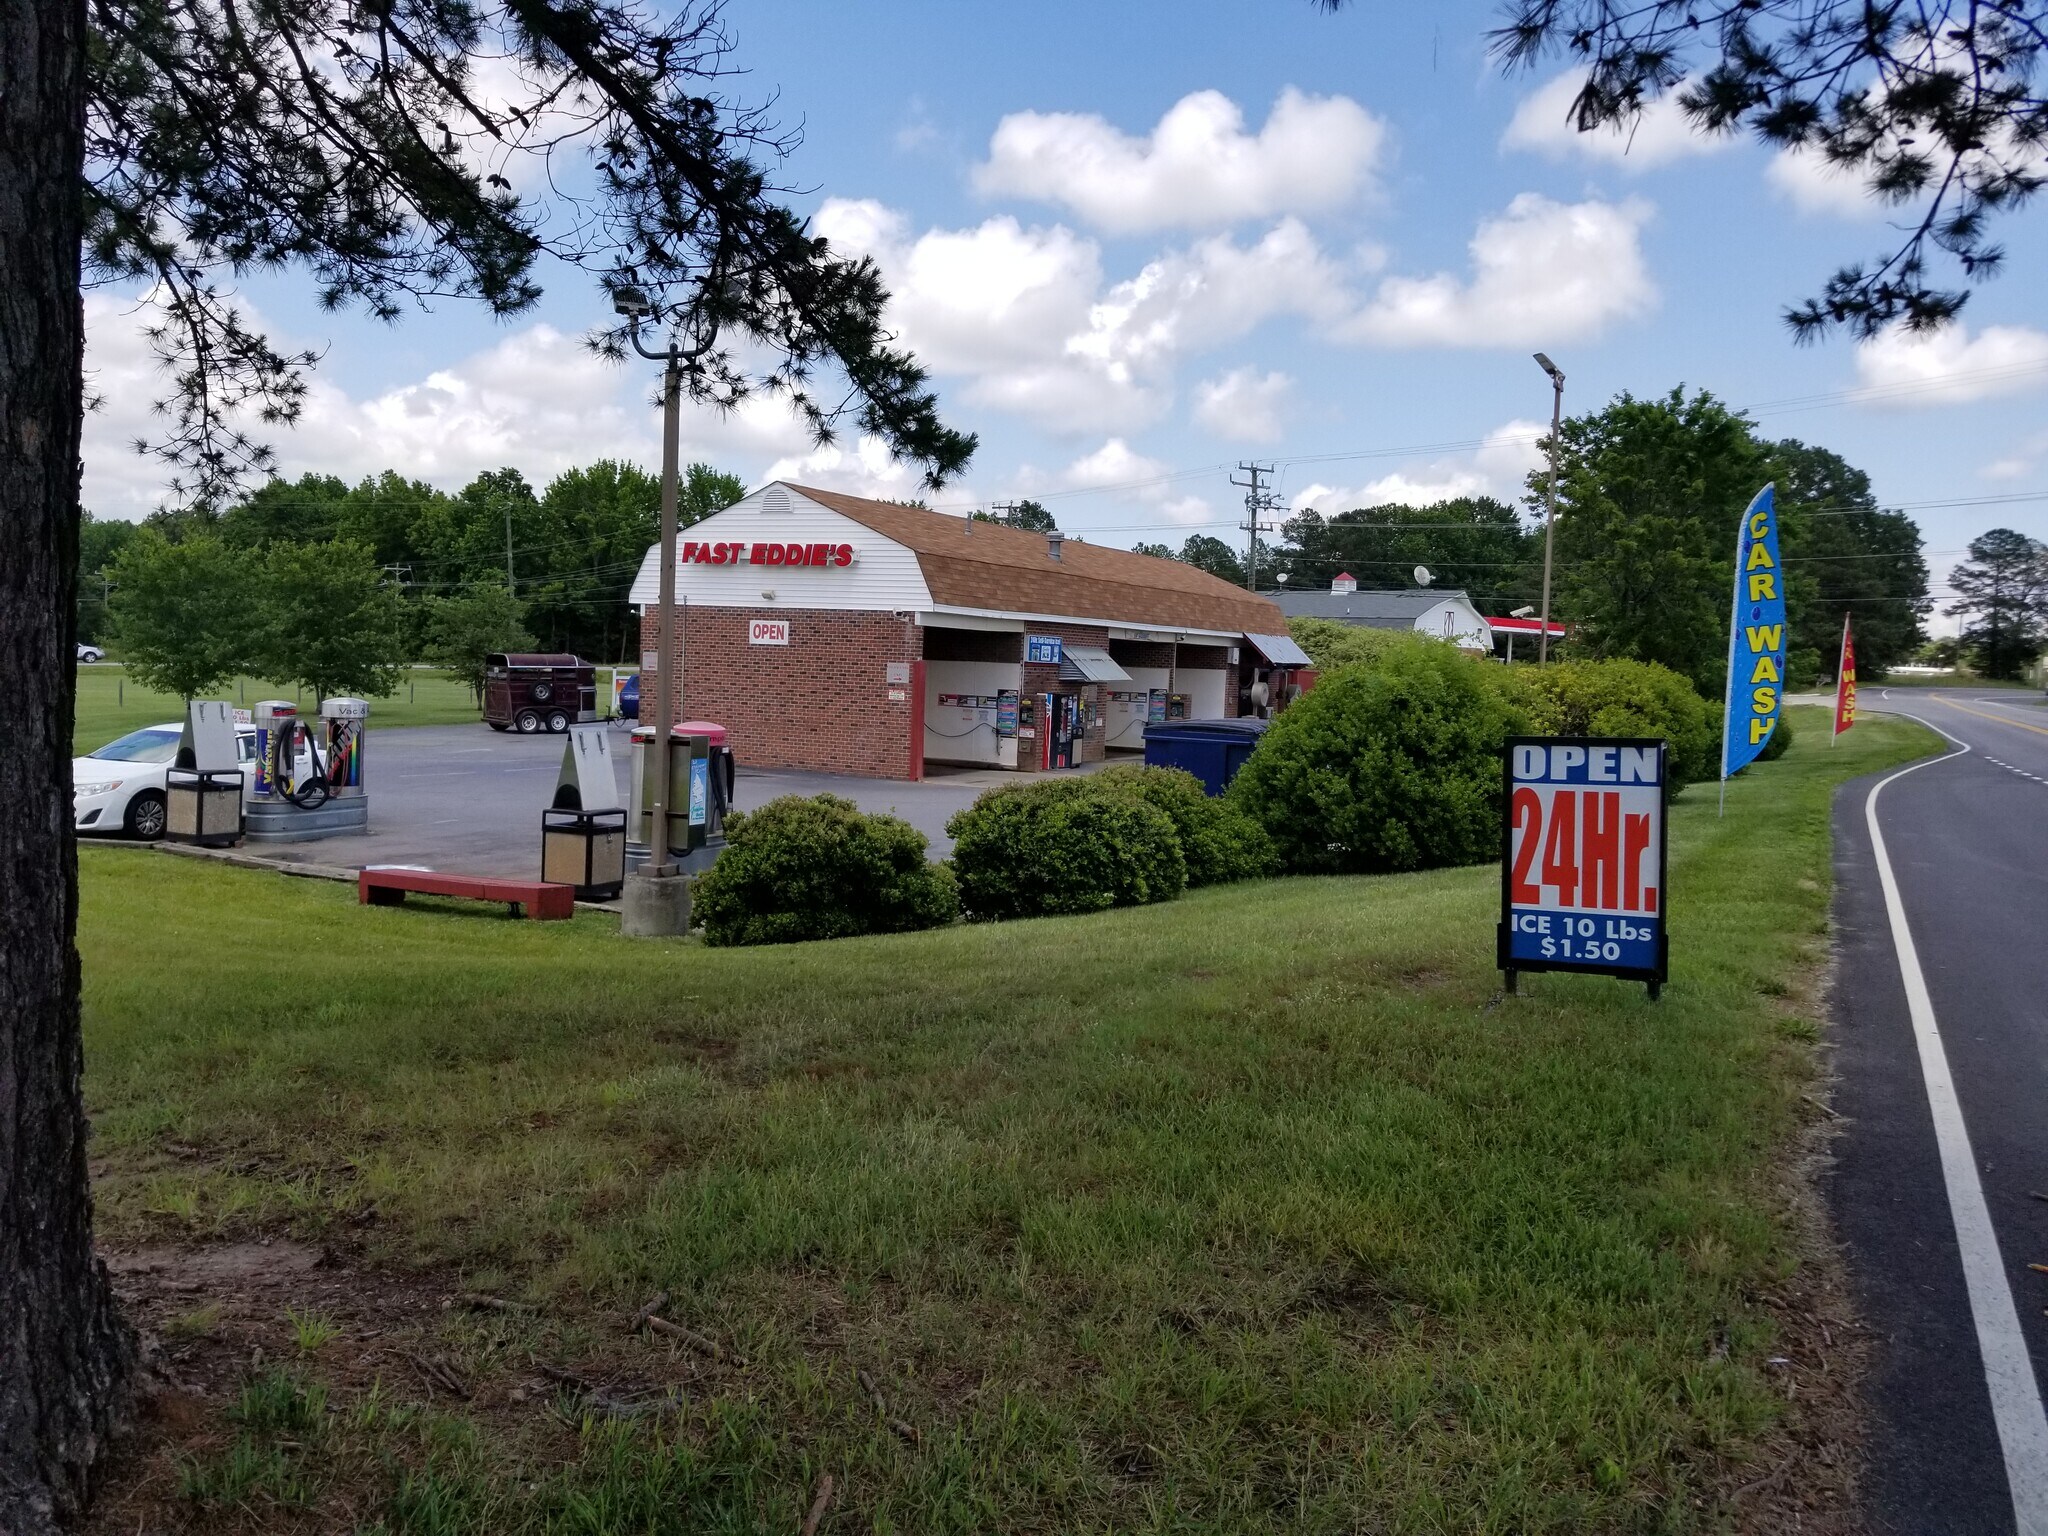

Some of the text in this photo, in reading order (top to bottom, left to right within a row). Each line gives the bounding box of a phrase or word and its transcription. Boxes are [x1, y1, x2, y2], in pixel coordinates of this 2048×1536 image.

[682, 542, 853, 567] FAST EDDIE'S
[753, 624, 785, 640] OPEN
[1745, 511, 1782, 745] CAR WASH
[1842, 668, 1856, 723] WASH
[339, 707, 357, 715] Vac
[1512, 744, 1658, 783] OPEN
[1511, 786, 1657, 913] 24Hr.
[1511, 913, 1652, 942] ICE 10 Lbs
[1540, 935, 1621, 961] $1.50
